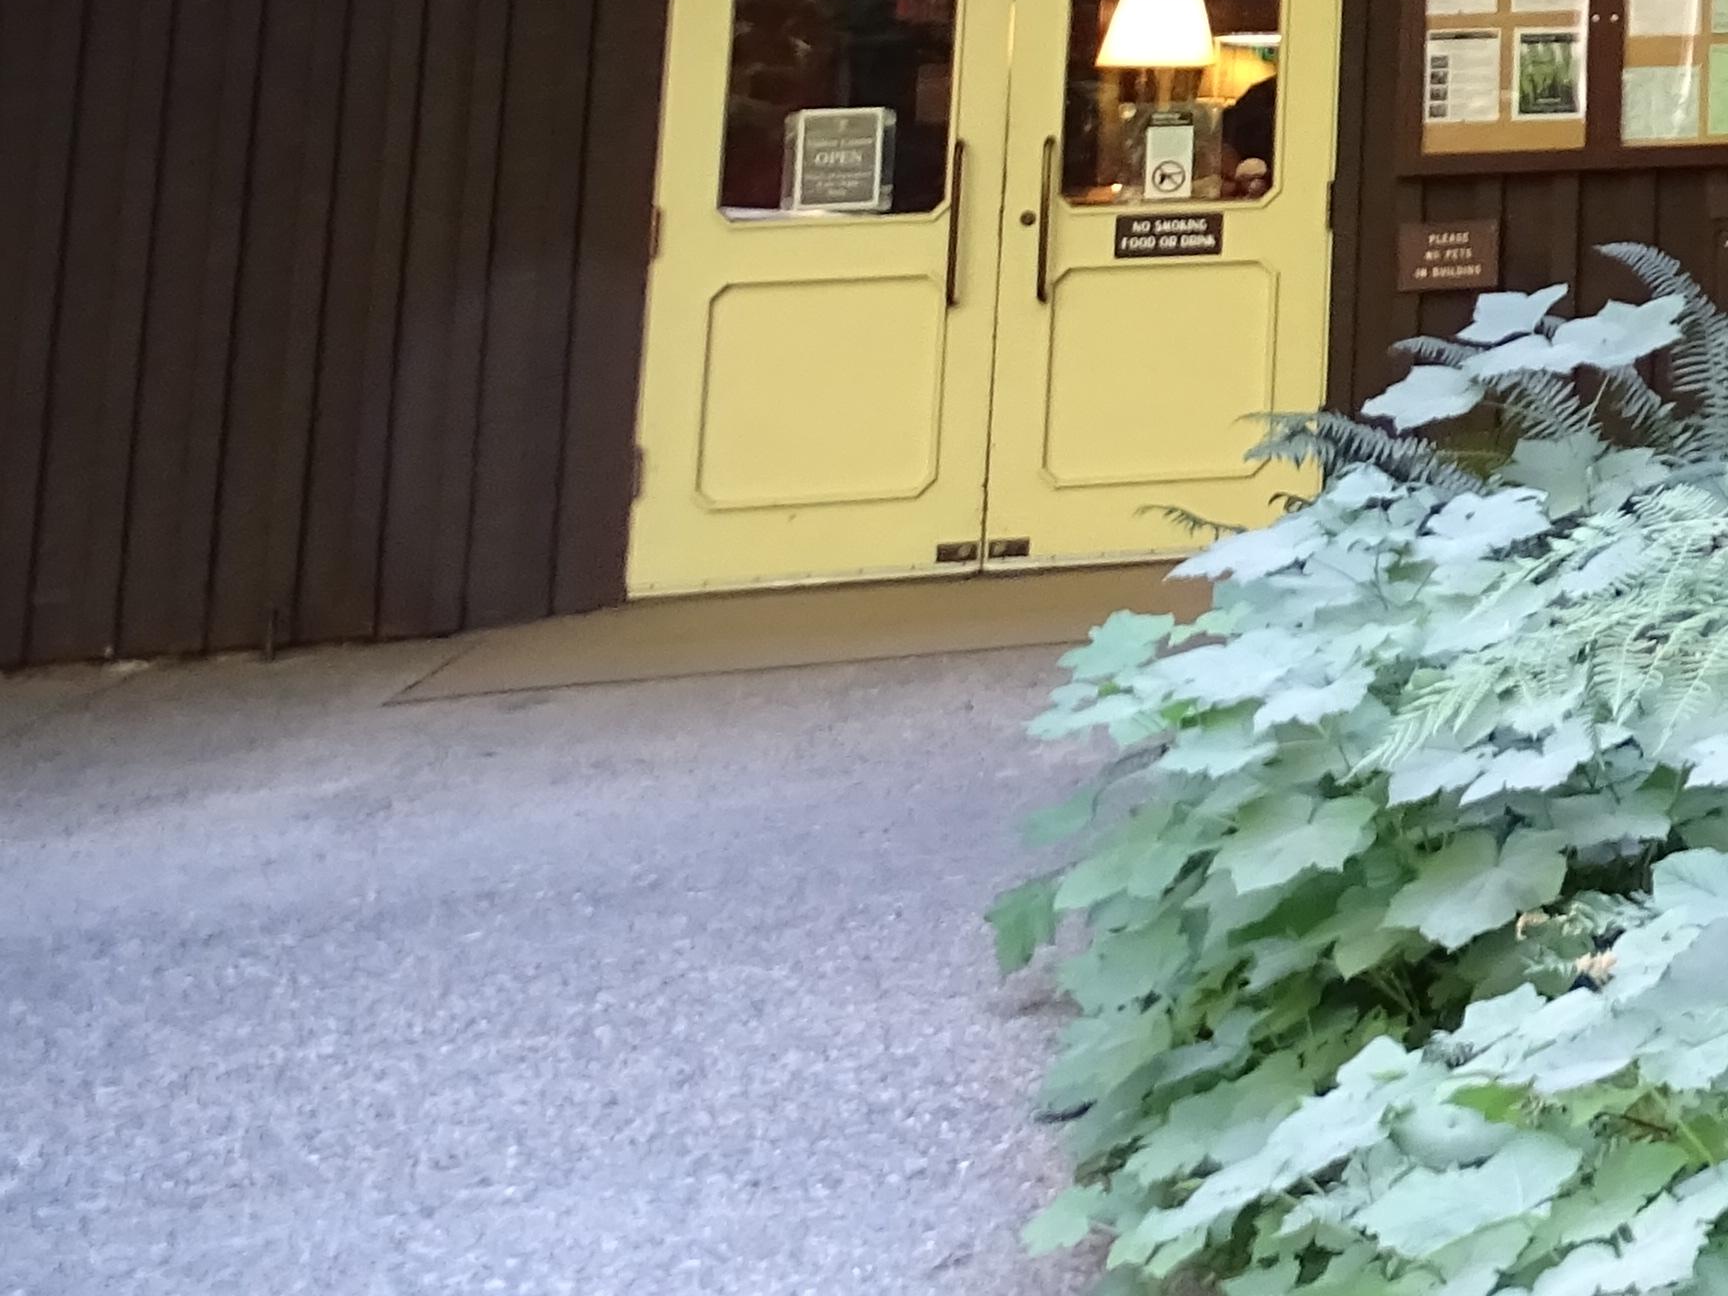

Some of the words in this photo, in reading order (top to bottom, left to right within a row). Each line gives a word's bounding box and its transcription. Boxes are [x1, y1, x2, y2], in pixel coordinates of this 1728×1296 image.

[1132, 220, 1151, 233] NO
[1154, 218, 1207, 233] SMOKING
[1121, 236, 1156, 250] FOOD
[1159, 235, 1178, 248] OR
[1180, 234, 1216, 248] DRINK
[1428, 232, 1469, 244] PLEASE
